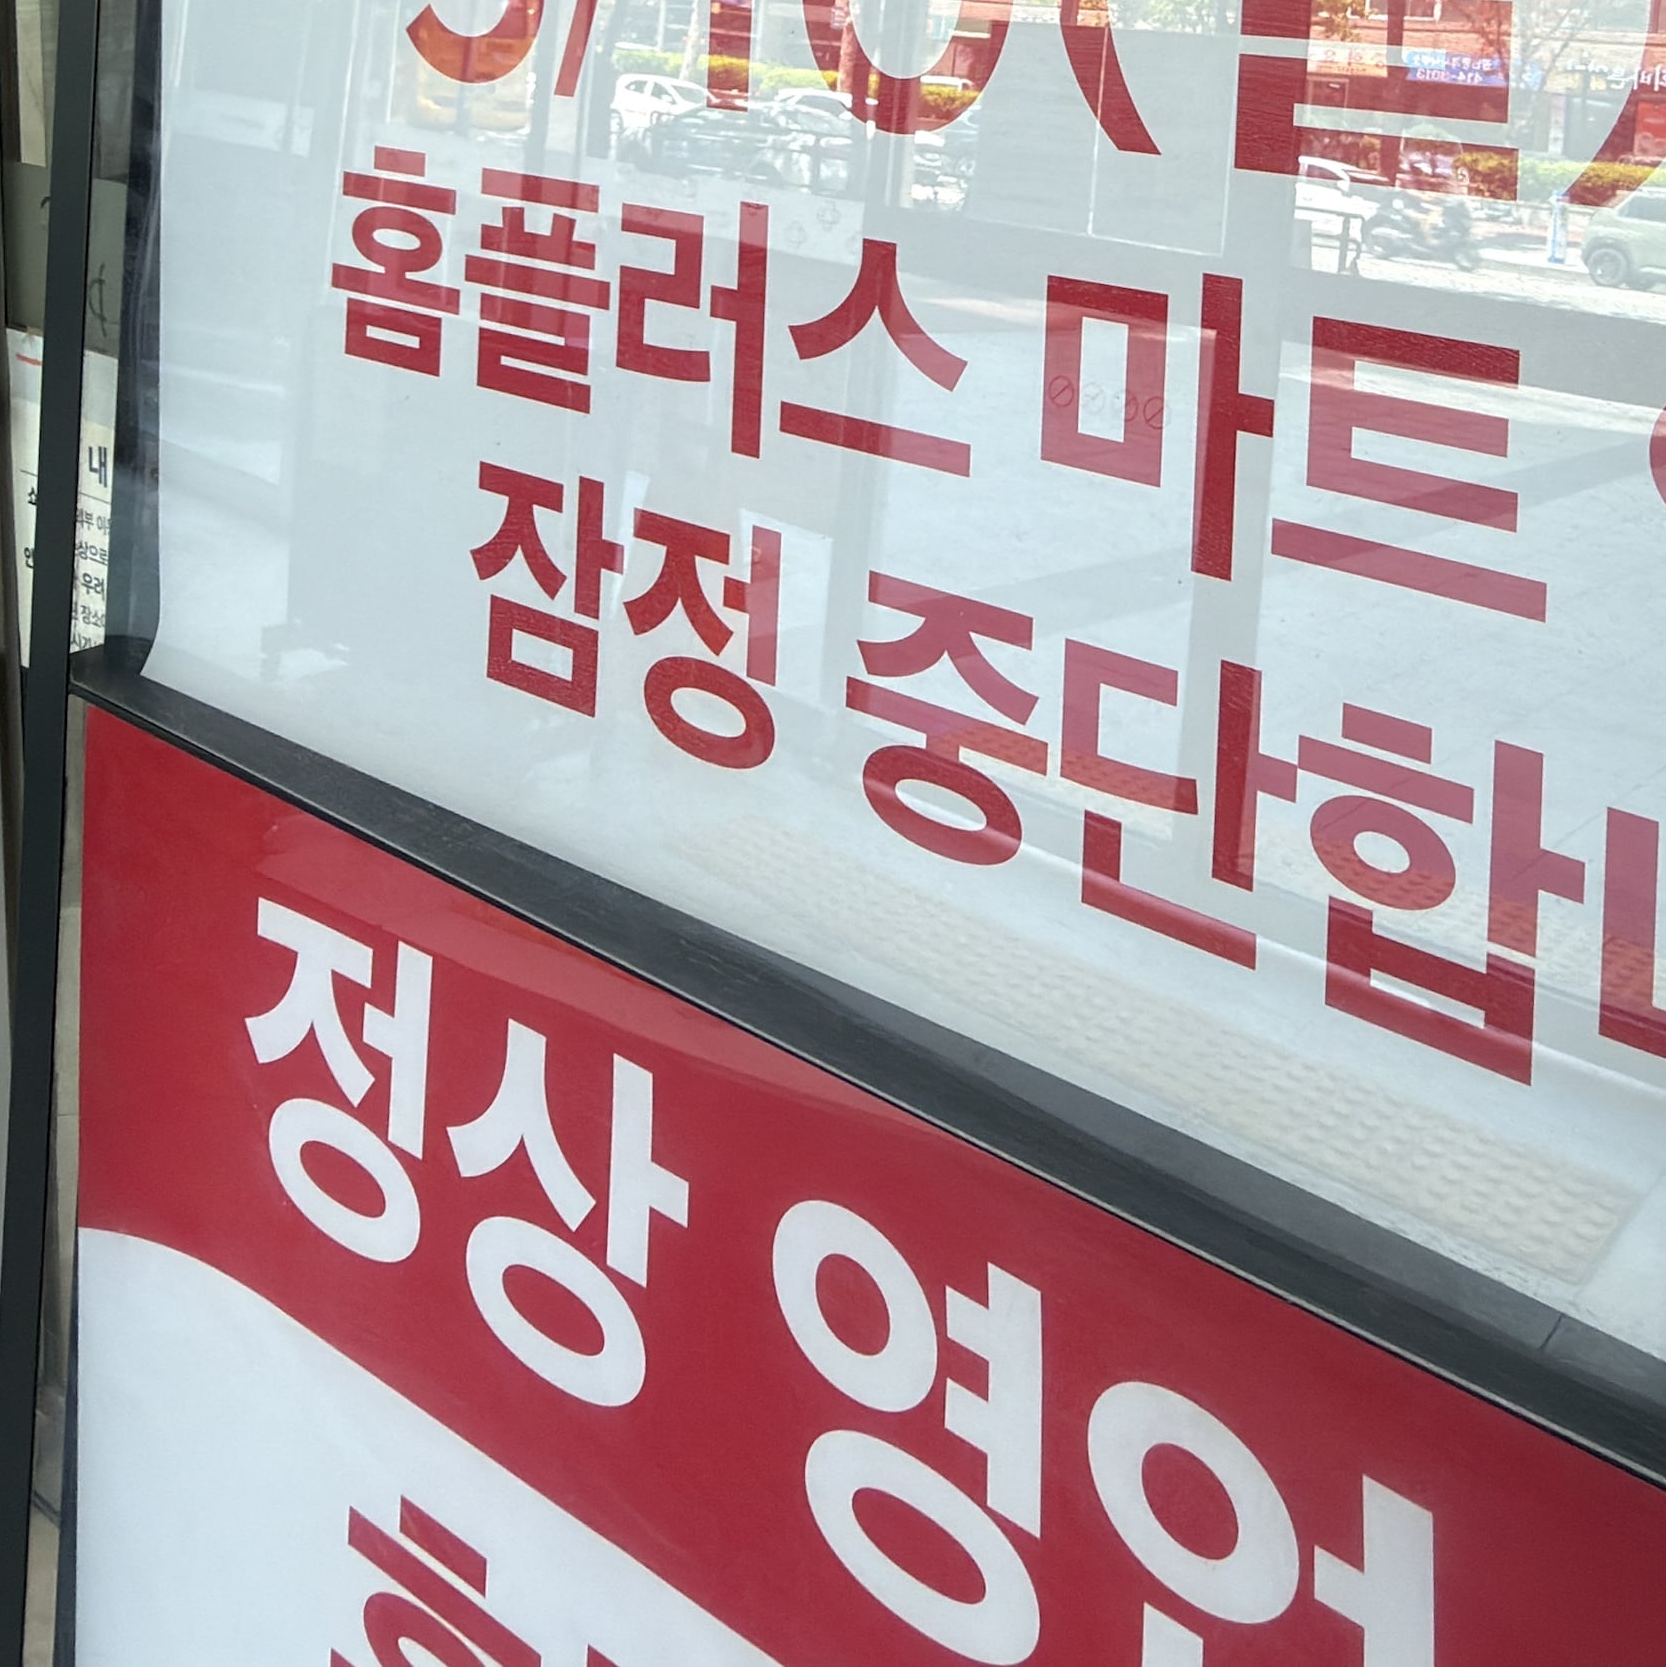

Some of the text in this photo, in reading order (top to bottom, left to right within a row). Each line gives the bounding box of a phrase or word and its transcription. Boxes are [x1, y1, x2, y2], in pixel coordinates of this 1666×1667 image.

[331, 146, 972, 478] 홈플러스
[1040, 274, 1548, 626] 마트
[470, 460, 783, 772] 잠정
[244, 897, 1435, 1667] 정상 영업
